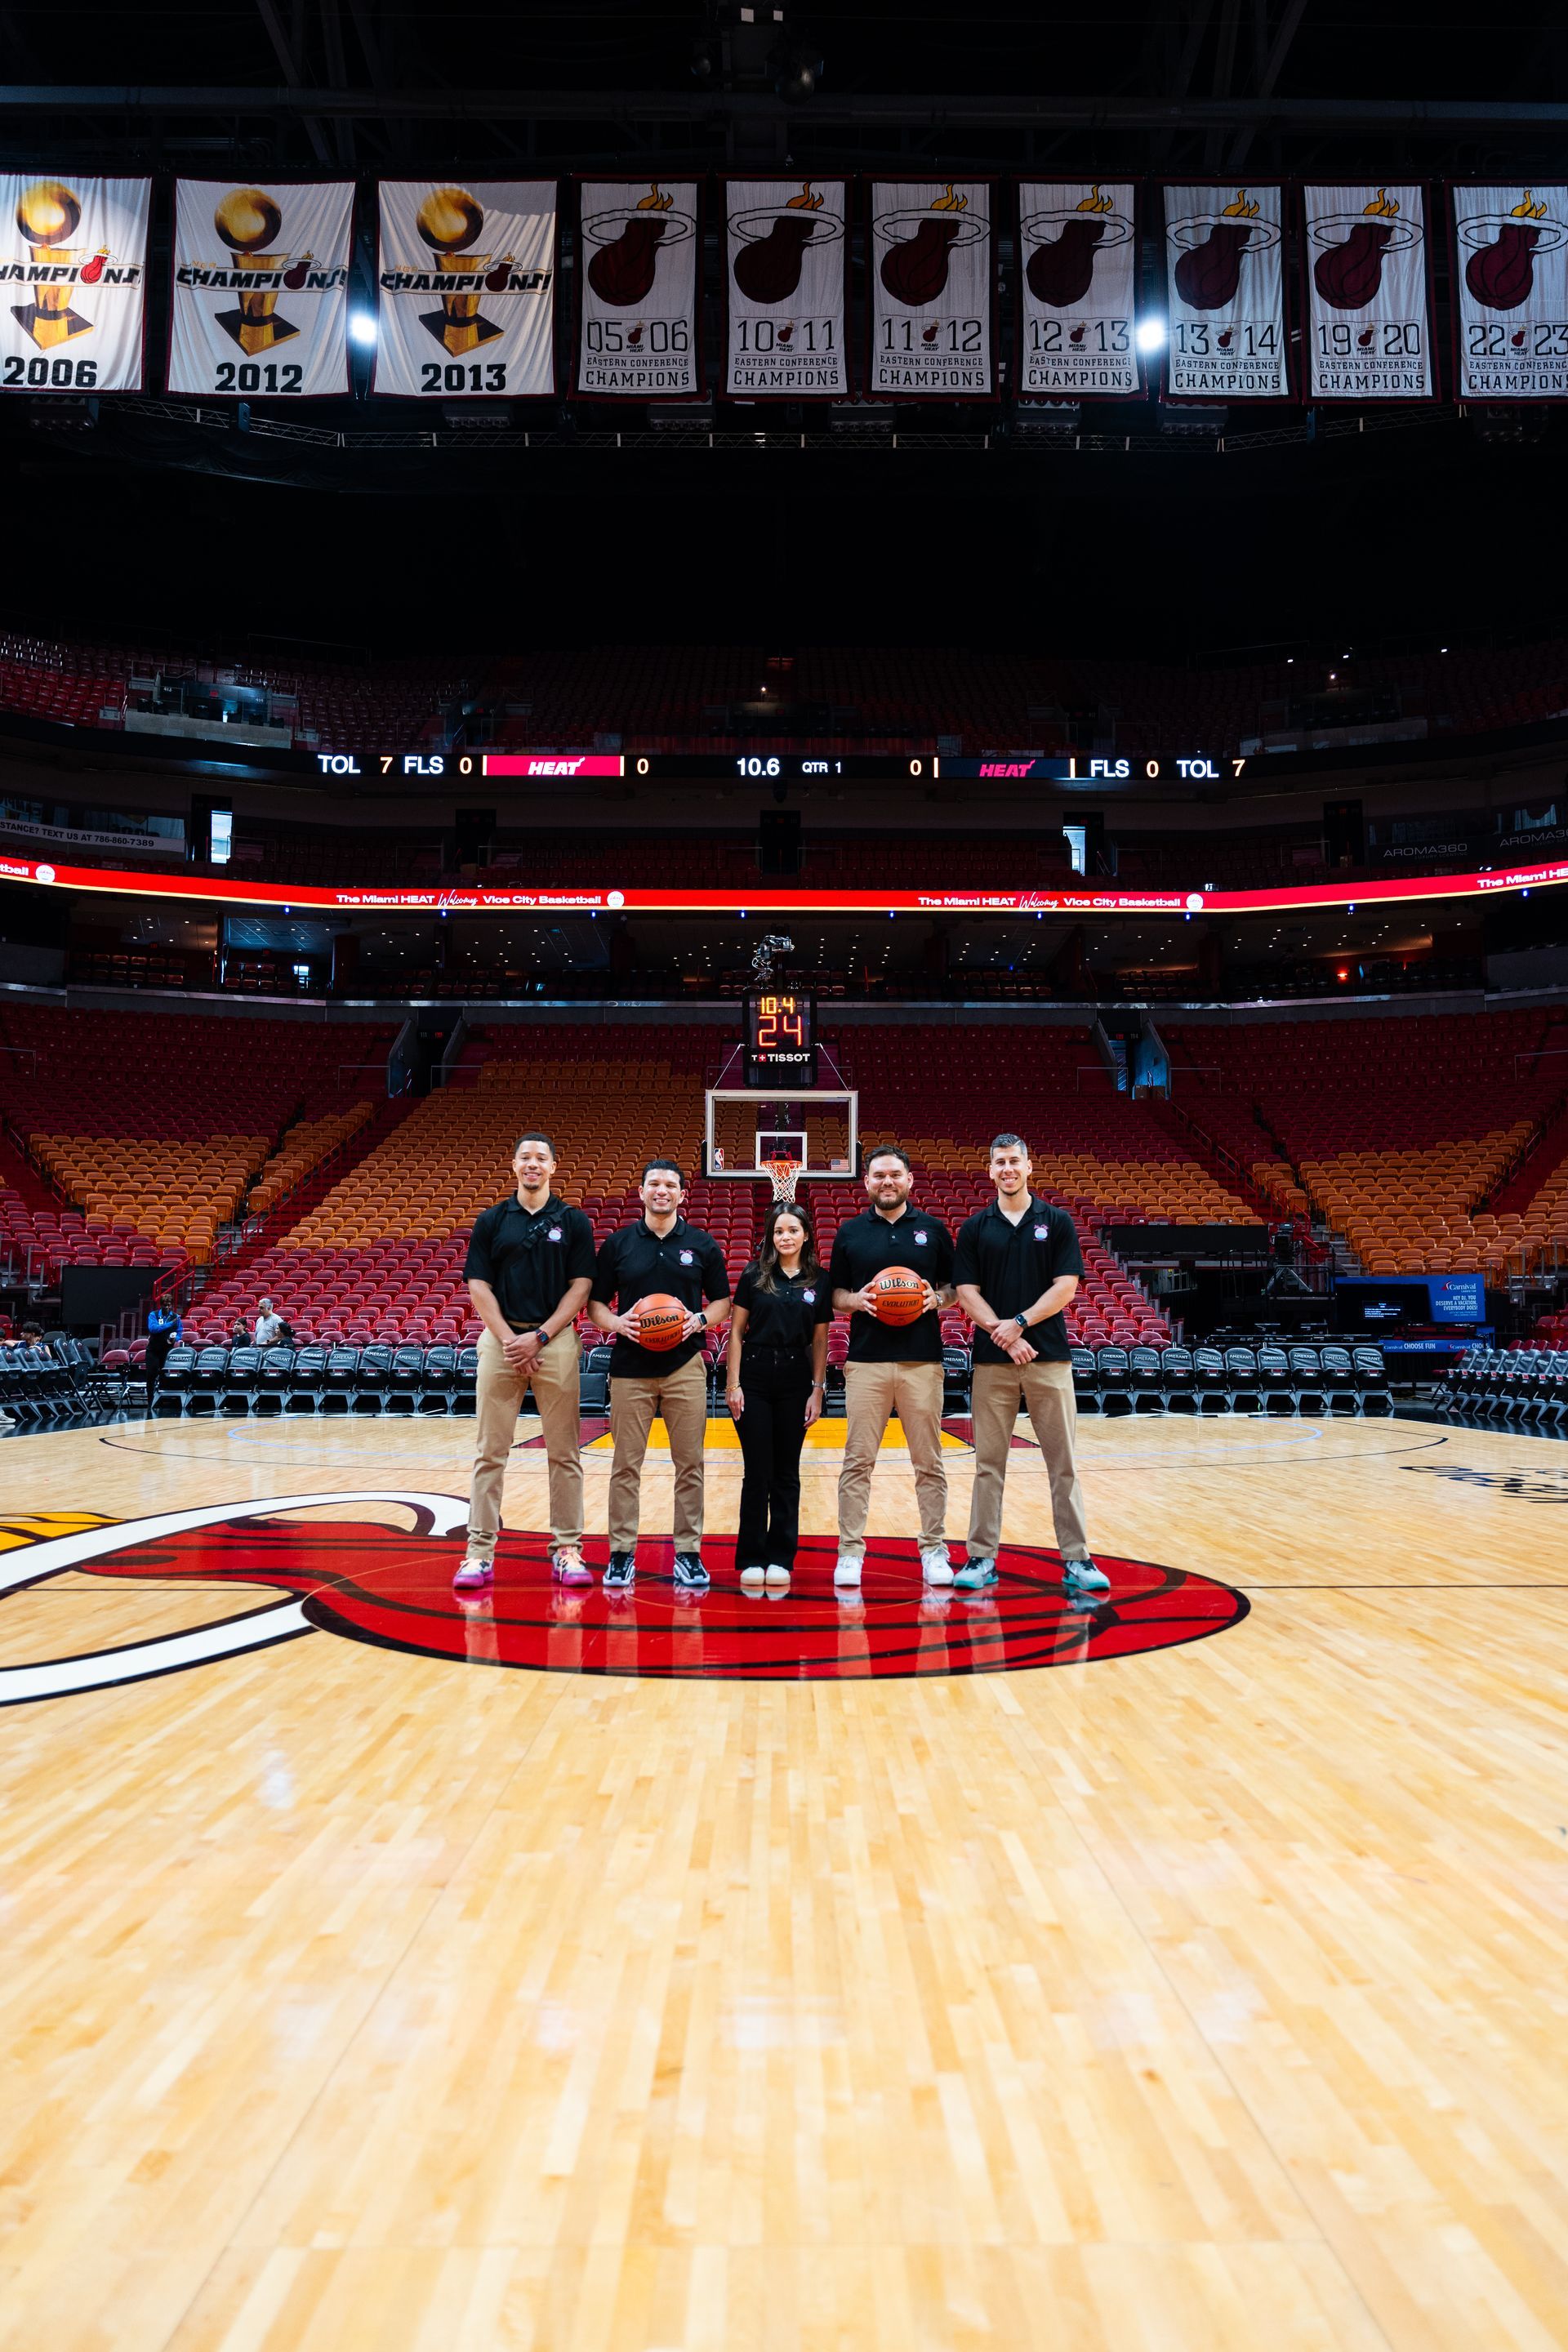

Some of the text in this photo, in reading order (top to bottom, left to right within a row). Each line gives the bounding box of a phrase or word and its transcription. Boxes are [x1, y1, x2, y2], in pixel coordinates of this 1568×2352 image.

[587, 320, 688, 352] 05 06
[737, 320, 834, 352] 10 11
[882, 318, 981, 352] 11 12
[1030, 319, 1129, 351] 12 13
[1176, 323, 1277, 356] 13 14
[1318, 323, 1420, 355] 19 20
[1469, 324, 1505, 356] 22
[587, 357, 688, 367] EASTERN CONFERENCE
[735, 357, 837, 367] EASTERN CONFERENCE
[880, 355, 982, 367] EASTERN CONFERENCE
[1030, 356, 1069, 367] EASTERN
[1176, 359, 1279, 370] EASTERN CONFERENCE
[1320, 360, 1423, 369] EASTERN CONFERENCE
[1470, 361, 1511, 370] EASTERN
[3, 356, 97, 388] 2006
[215, 363, 303, 393] 2012
[421, 363, 506, 392] 2013
[586, 371, 688, 386] CHAMPIONS
[734, 370, 838, 385] CHAMPIONS
[880, 369, 984, 385] CHAMPIONS
[1029, 370, 1132, 386] CHAMPIONS
[1176, 373, 1280, 389] CHAMPIONS
[1320, 374, 1424, 389] CHAMPIONS
[1468, 375, 1568, 389] CHAMPION
[318, 755, 1245, 778] TOL 7 FLS 0 HEAT 0 10.6 QTR 1 0 HEAT FLS 0 TOL 7
[0, 822, 154, 847] STANCE? TEXT US AT 786-860-7389
[1383, 843, 1468, 858] AROMA360
[1477, 879, 1503, 889] The
[1506, 870, 1547, 885] Miami
[336, 894, 357, 904] The
[363, 894, 399, 904] Miami
[400, 895, 435, 904] HEAT
[438, 889, 479, 907] Welcomes
[483, 895, 509, 905] Vice
[512, 895, 538, 906] City
[539, 895, 602, 905] Basketball
[918, 897, 942, 906] The
[944, 897, 980, 906] Miami
[982, 897, 1016, 906] HEAT
[1019, 891, 1059, 909] Welcomes
[1063, 898, 1090, 906] Vice
[1093, 898, 1116, 909] City
[1119, 898, 1181, 907] Basketball
[760, 997, 794, 1014] 10.4
[759, 1015, 802, 1046] 24
[767, 1054, 811, 1062] TISSOT
[880, 1277, 920, 1291] Wilson
[883, 1299, 920, 1307] EVOLUTION
[640, 1314, 679, 1329] Wilson
